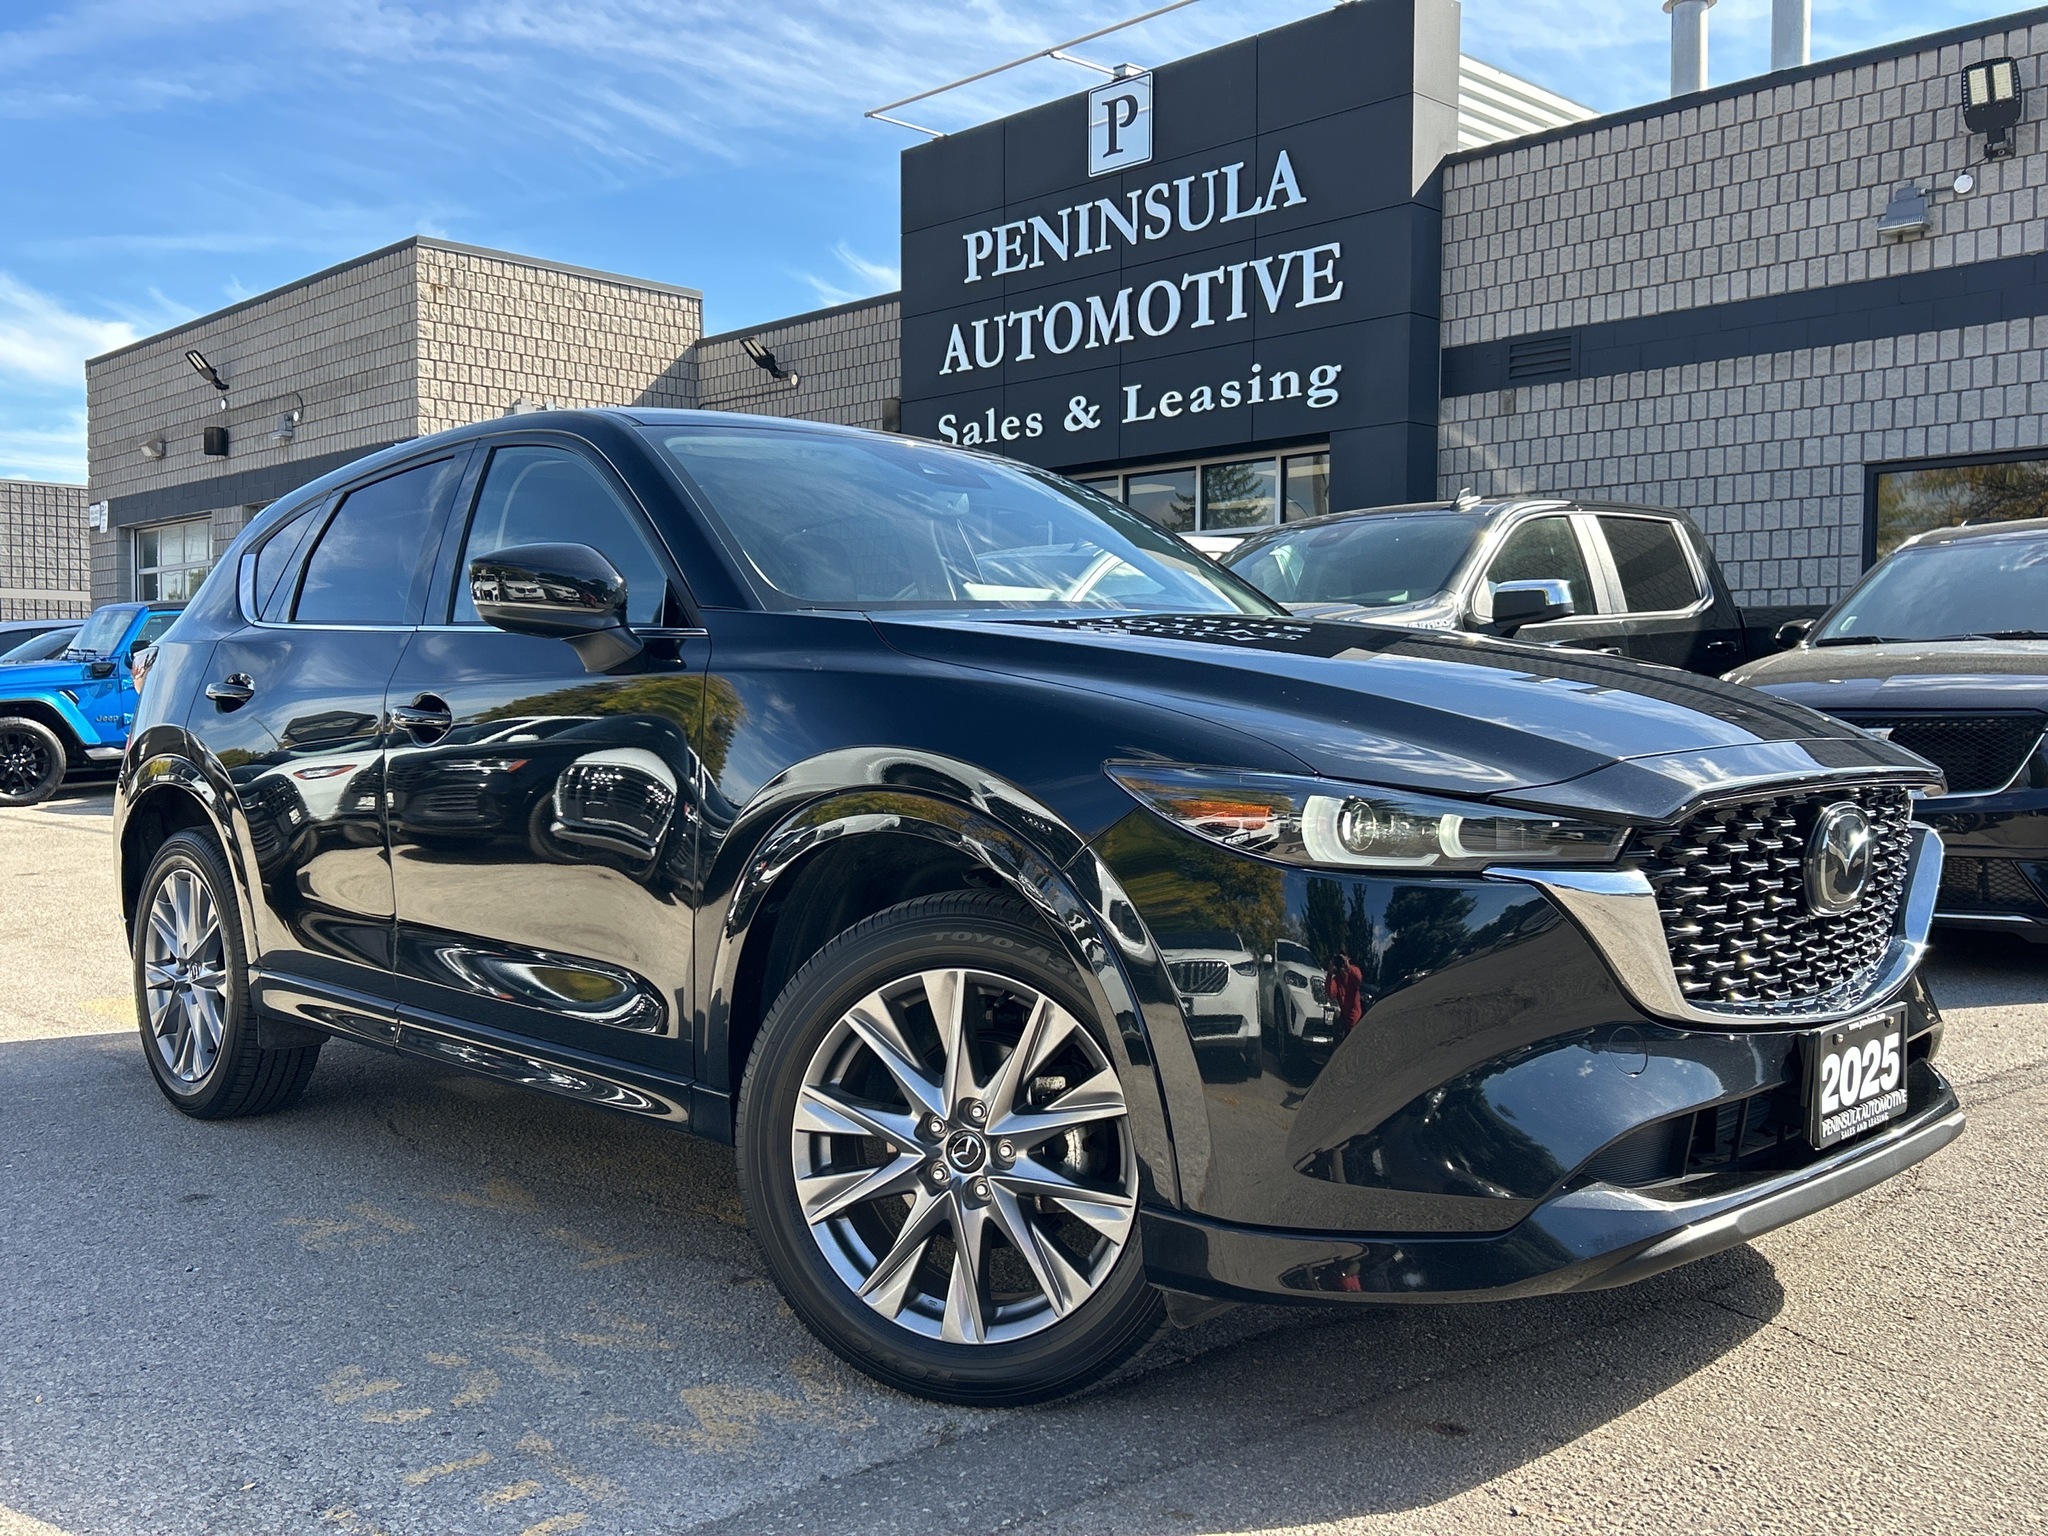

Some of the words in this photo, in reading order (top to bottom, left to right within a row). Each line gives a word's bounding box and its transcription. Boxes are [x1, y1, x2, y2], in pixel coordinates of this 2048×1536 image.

[1102, 94, 1139, 158] P
[963, 149, 1307, 284] PENINSULA
[939, 242, 1344, 376] AUTOMOTIVE
[938, 408, 1043, 446] Sales
[1063, 395, 1101, 432] &
[1122, 363, 1342, 424] Leasing
[95, 715, 119, 723] Jeep
[931, 931, 1015, 949] TOYO
[1821, 1032, 1900, 1114] 2025
[1821, 1106, 1863, 1138] PENINSULA
[1861, 1088, 1907, 1120] AUTOMOTIVE
